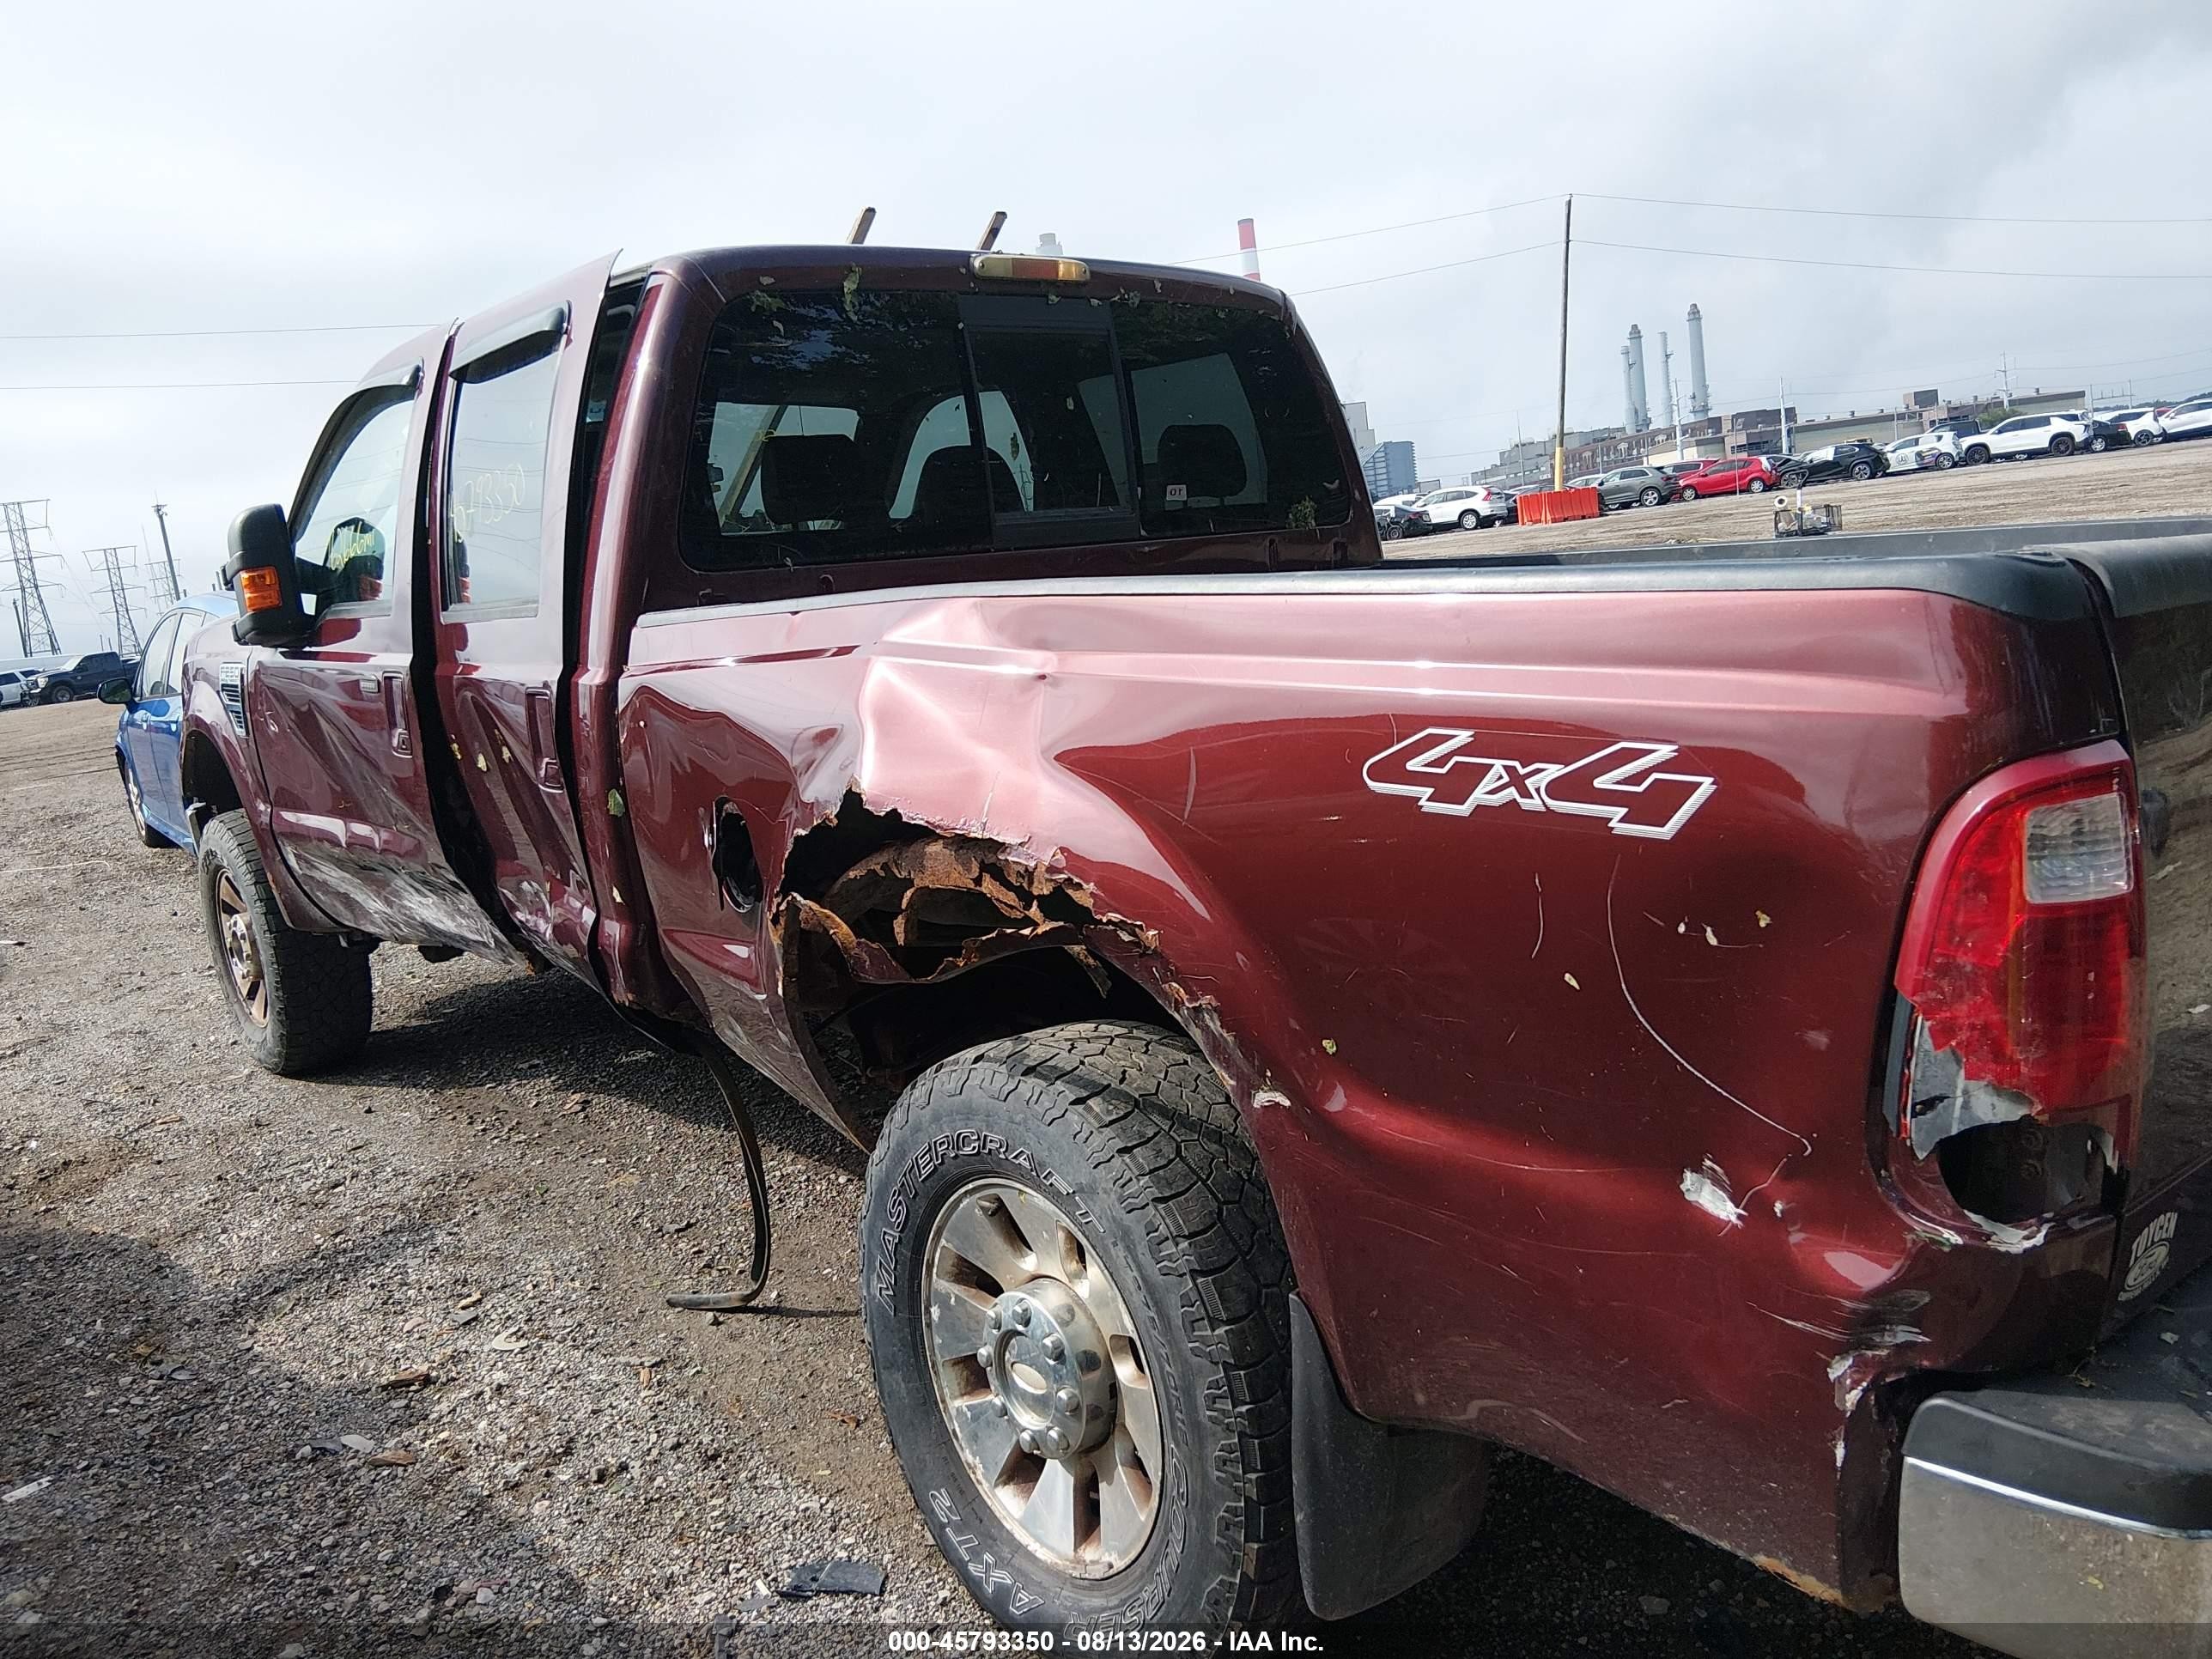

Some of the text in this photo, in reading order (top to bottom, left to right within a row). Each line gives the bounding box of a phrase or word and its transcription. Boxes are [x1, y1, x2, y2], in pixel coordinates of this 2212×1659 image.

[1362, 726, 1718, 841] 4x4
[877, 1129, 1106, 1317] MASTERCRAFT
[928, 1443, 1189, 1643] COURSER AXT2
